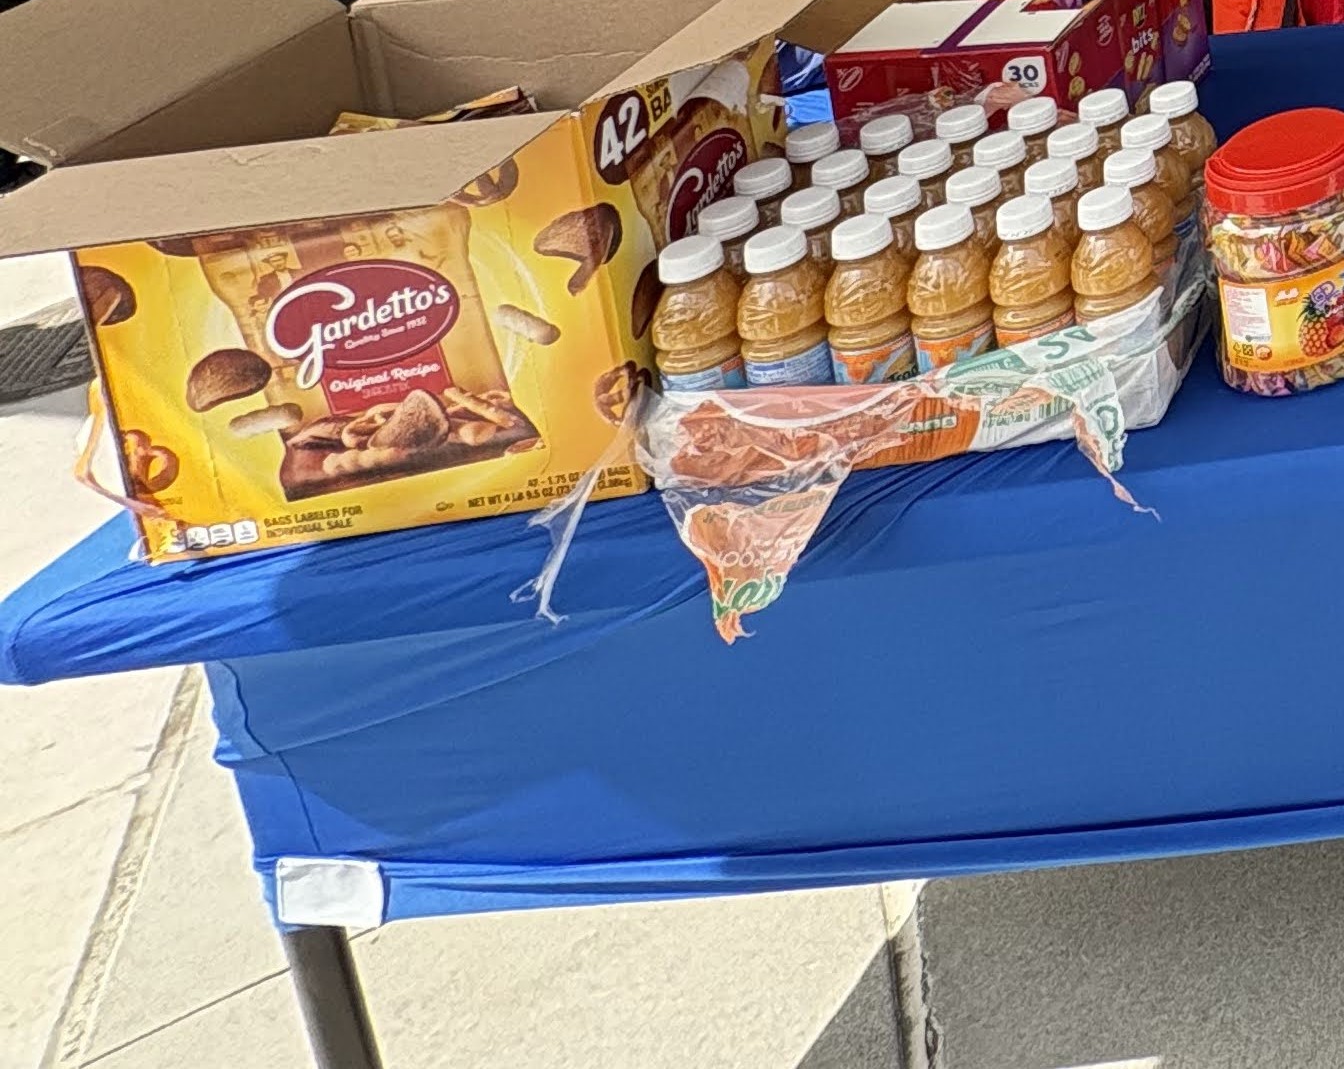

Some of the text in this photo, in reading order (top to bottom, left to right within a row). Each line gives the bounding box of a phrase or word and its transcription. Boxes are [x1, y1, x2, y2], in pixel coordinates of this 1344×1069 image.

[1131, 28, 1154, 54] bits
[1008, 65, 1039, 81] 30
[599, 96, 647, 172] 42
[265, 281, 451, 390] Gardetto's
[330, 362, 441, 392] Original Recipe
[468, 498, 486, 508] NET
[488, 495, 502, 506] WT
[264, 505, 363, 528] BAGS LABELED FOR
[327, 519, 354, 530] SALE
